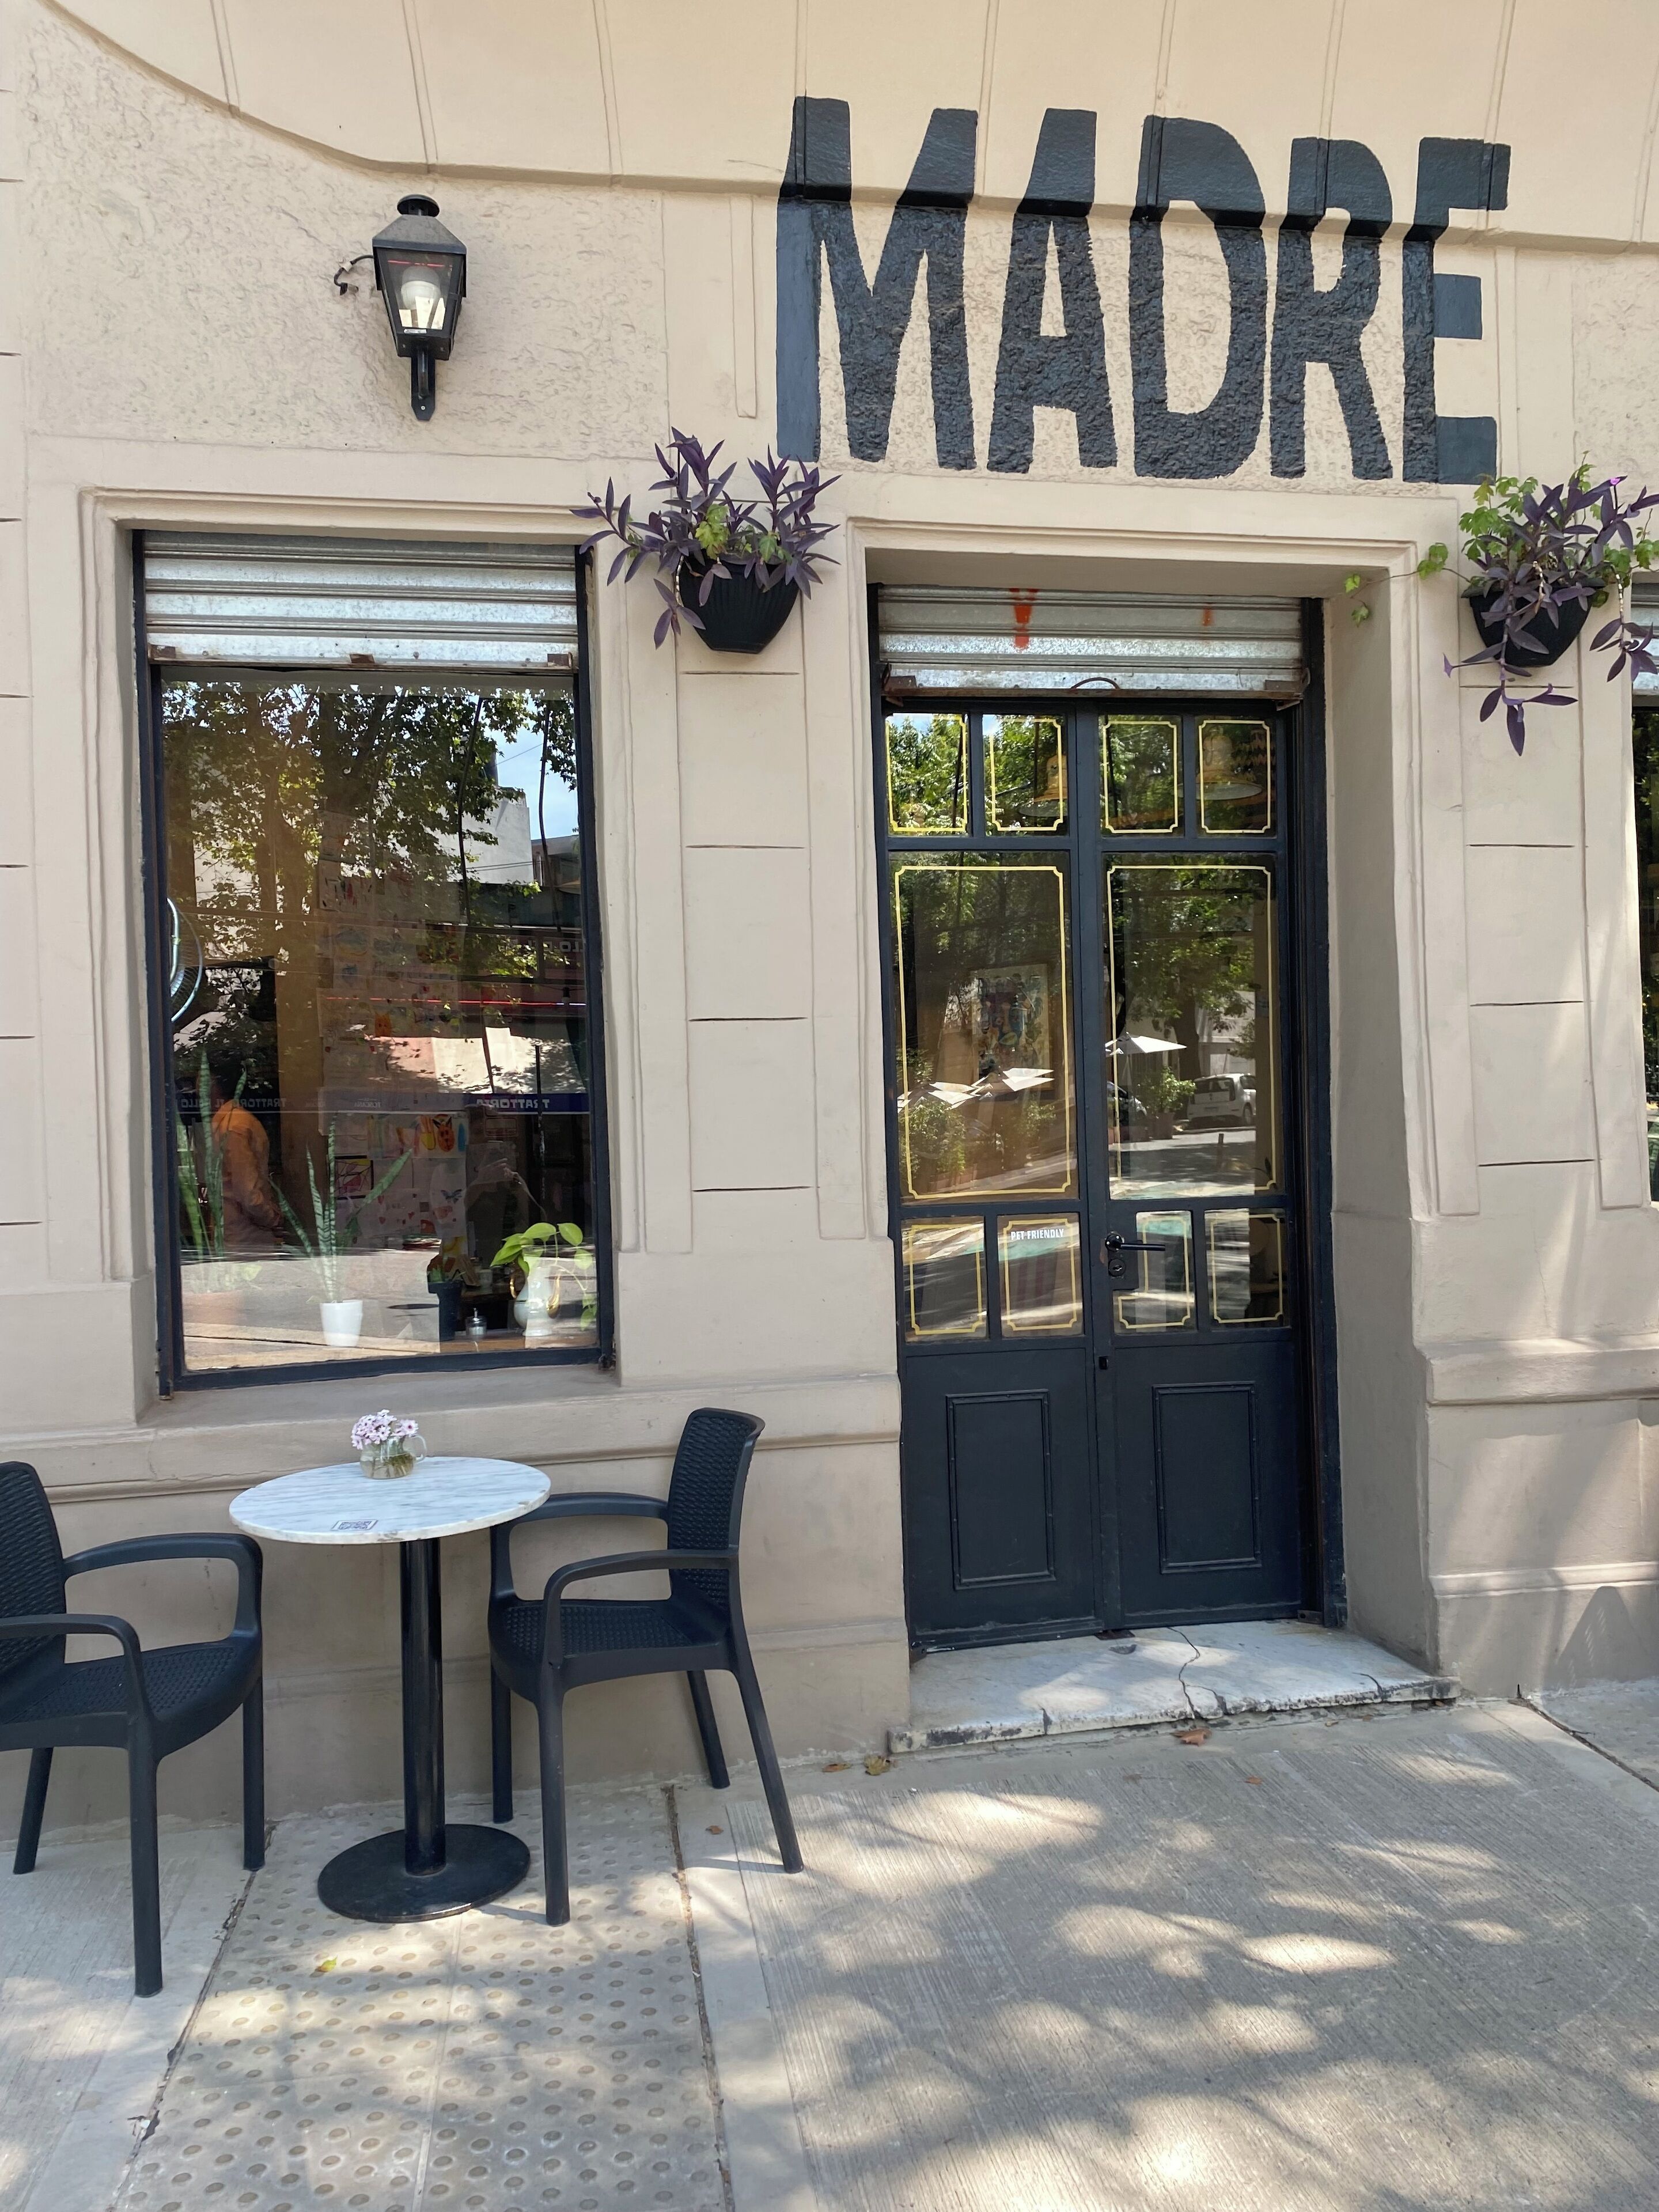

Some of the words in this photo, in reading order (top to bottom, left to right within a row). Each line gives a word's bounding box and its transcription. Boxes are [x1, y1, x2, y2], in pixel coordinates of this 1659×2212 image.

[777, 96, 1511, 484] MADRE
[1011, 1231, 1025, 1240] PET
[1027, 1229, 1064, 1240] FRIENDLY
